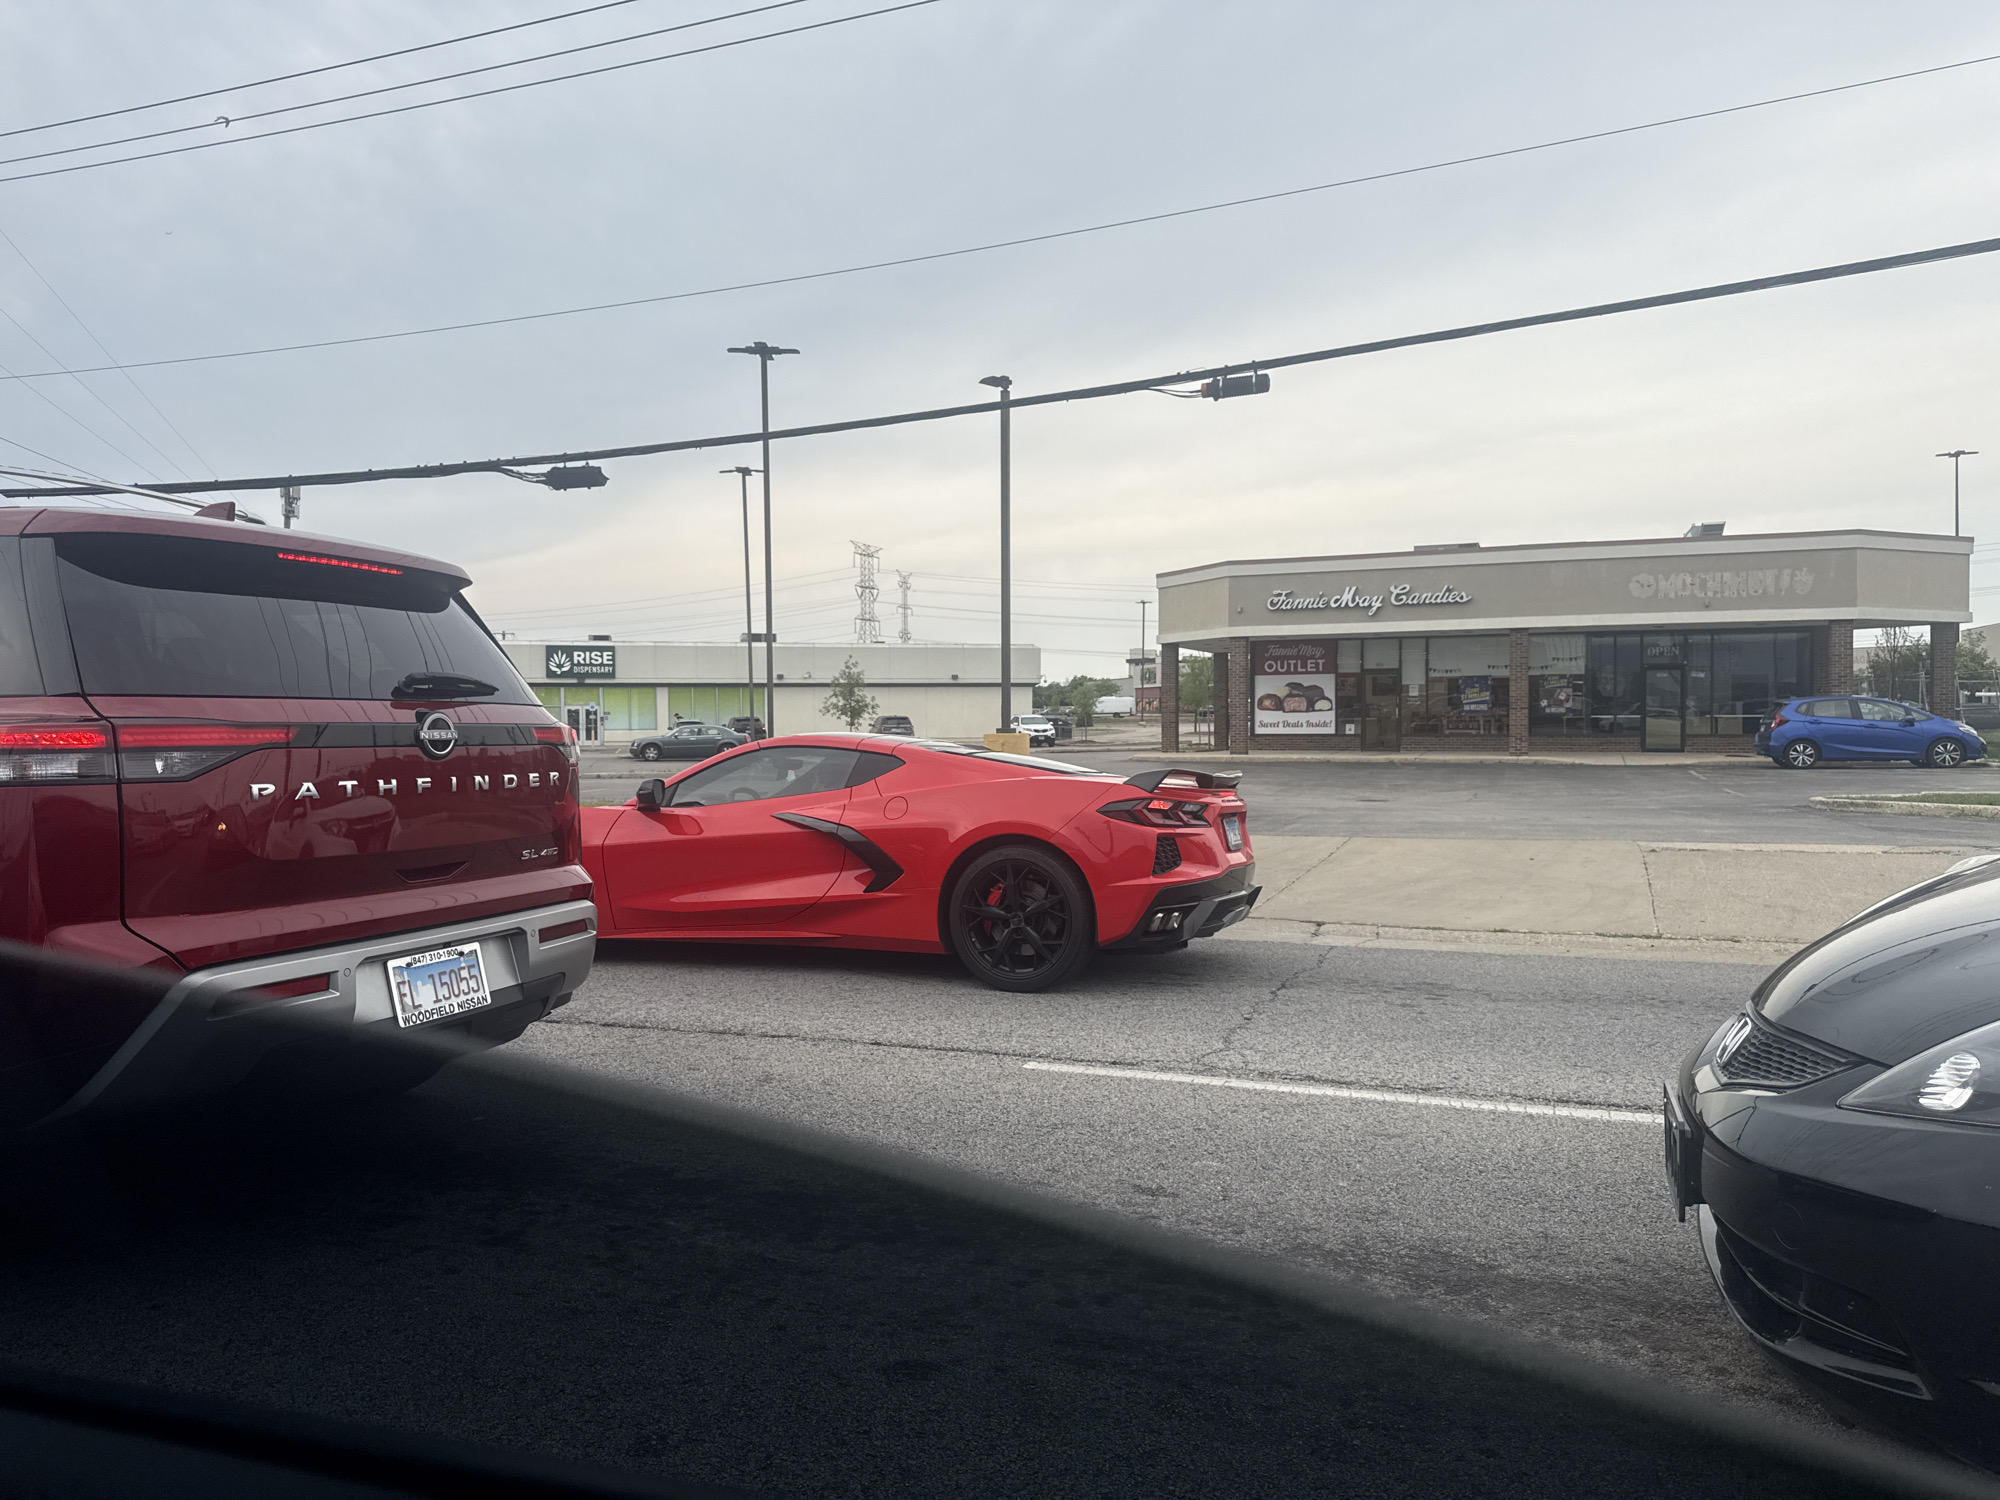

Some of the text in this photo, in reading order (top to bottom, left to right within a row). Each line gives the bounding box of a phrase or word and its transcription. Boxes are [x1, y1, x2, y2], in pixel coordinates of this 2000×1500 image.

[1267, 584, 1472, 616] Fannie May Candies
[1265, 643, 1325, 658] Fannie May
[1647, 646, 1680, 656] OPEN
[573, 651, 613, 665] RISE
[573, 665, 613, 674] DISPENSARY
[1264, 659, 1326, 673] OUTLET
[1258, 719, 1333, 728] Sweet Deals Inside!
[421, 731, 458, 739] NISSAN
[248, 771, 561, 802] PATHFINDER
[521, 848, 539, 860] SL
[410, 955, 428, 967] (847)
[428, 948, 459, 962] 310-1900
[396, 964, 481, 1013] FL 15055
[401, 994, 489, 1027] WOODFIELD NISSAN
